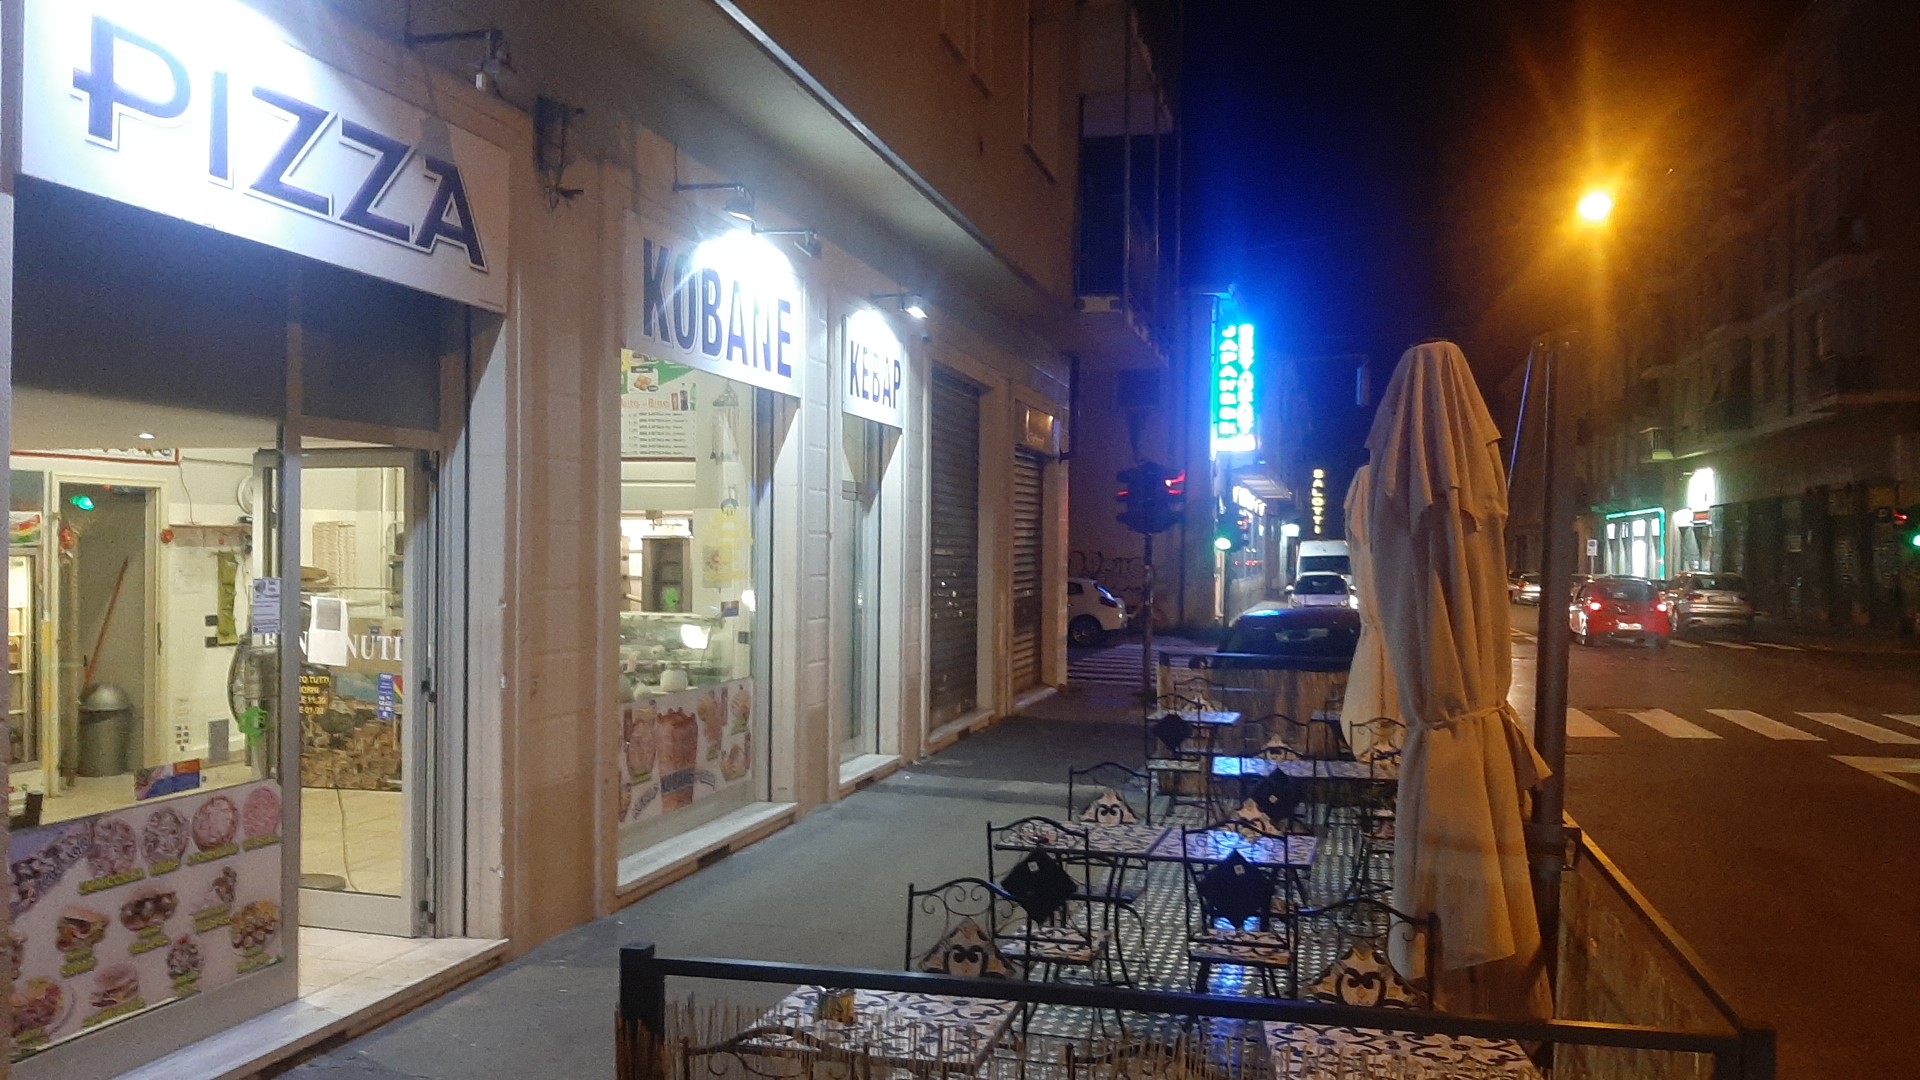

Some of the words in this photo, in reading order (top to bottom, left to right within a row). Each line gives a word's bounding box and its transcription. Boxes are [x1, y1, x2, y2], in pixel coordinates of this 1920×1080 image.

[69, 14, 489, 274] PIZZA
[643, 237, 792, 379] KOBANE
[850, 340, 901, 410] KEBAP
